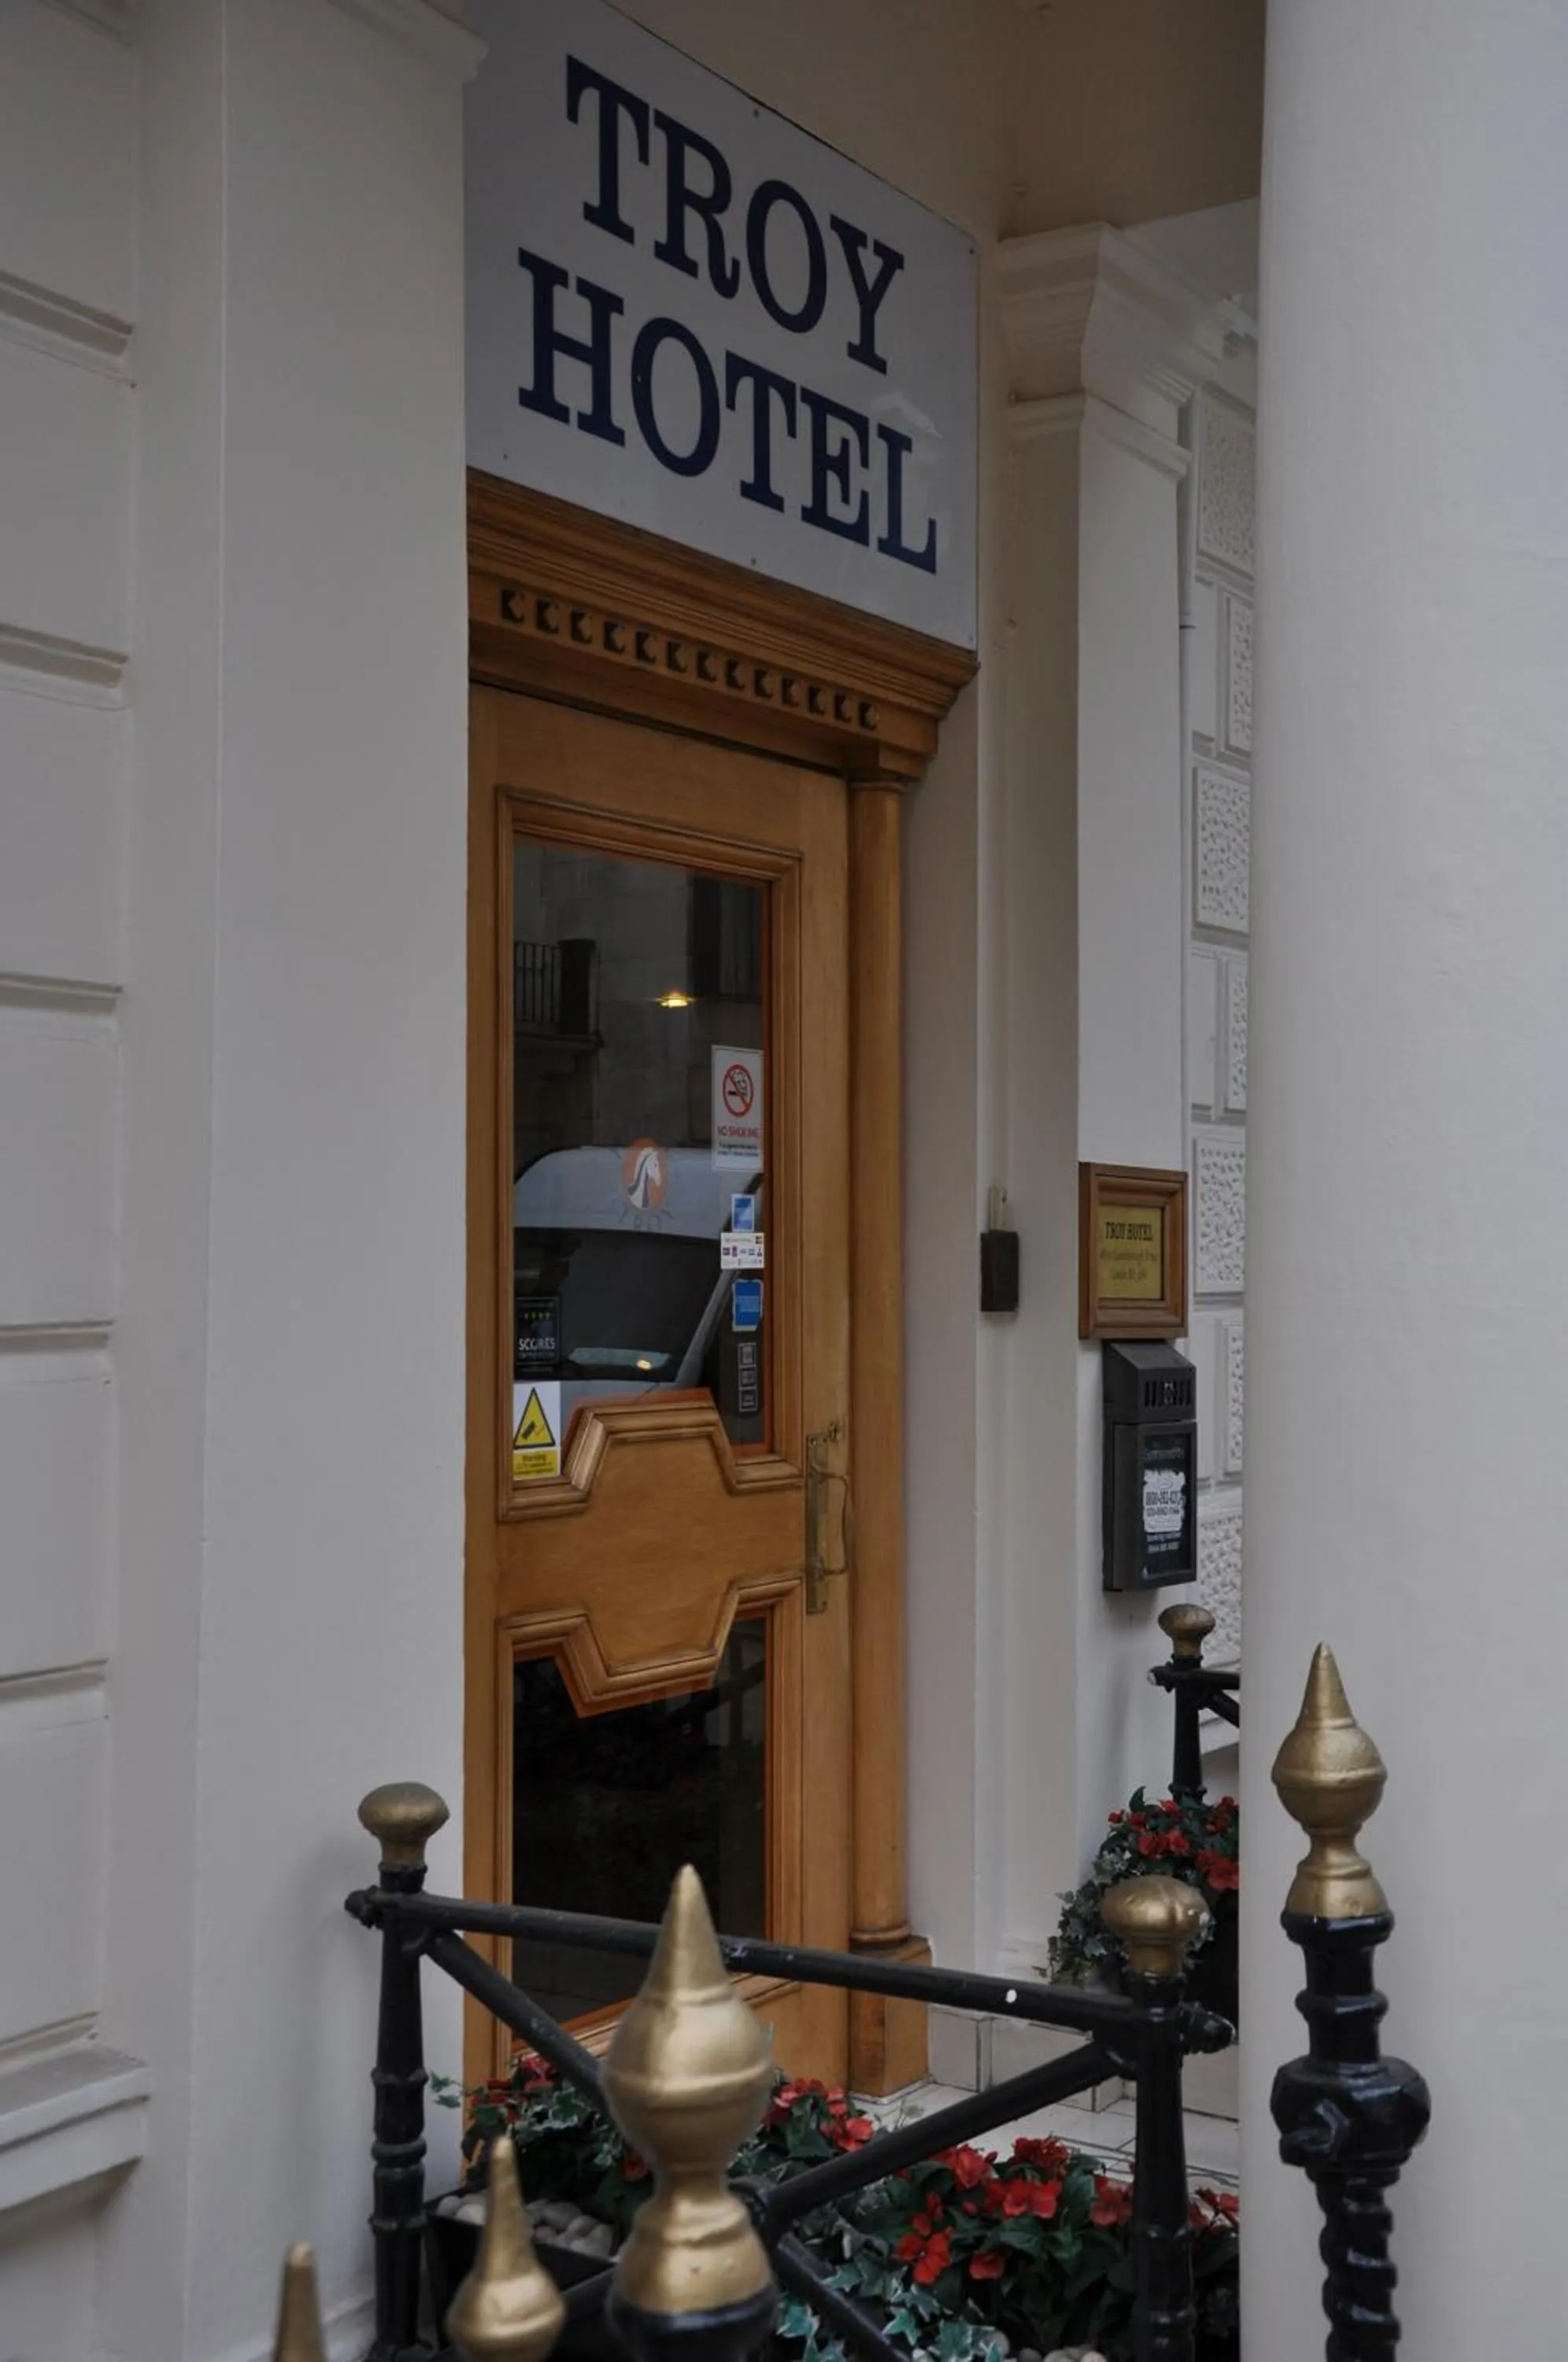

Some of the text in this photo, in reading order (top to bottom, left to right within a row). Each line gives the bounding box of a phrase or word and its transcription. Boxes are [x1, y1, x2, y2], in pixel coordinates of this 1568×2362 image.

[566, 54, 904, 375] TROY
[518, 247, 937, 575] HOTEL
[717, 1125, 760, 1138] NO SMOKING
[1106, 1221, 1153, 1242] TROY HOTEL
[518, 1336, 555, 1350] SCORES
